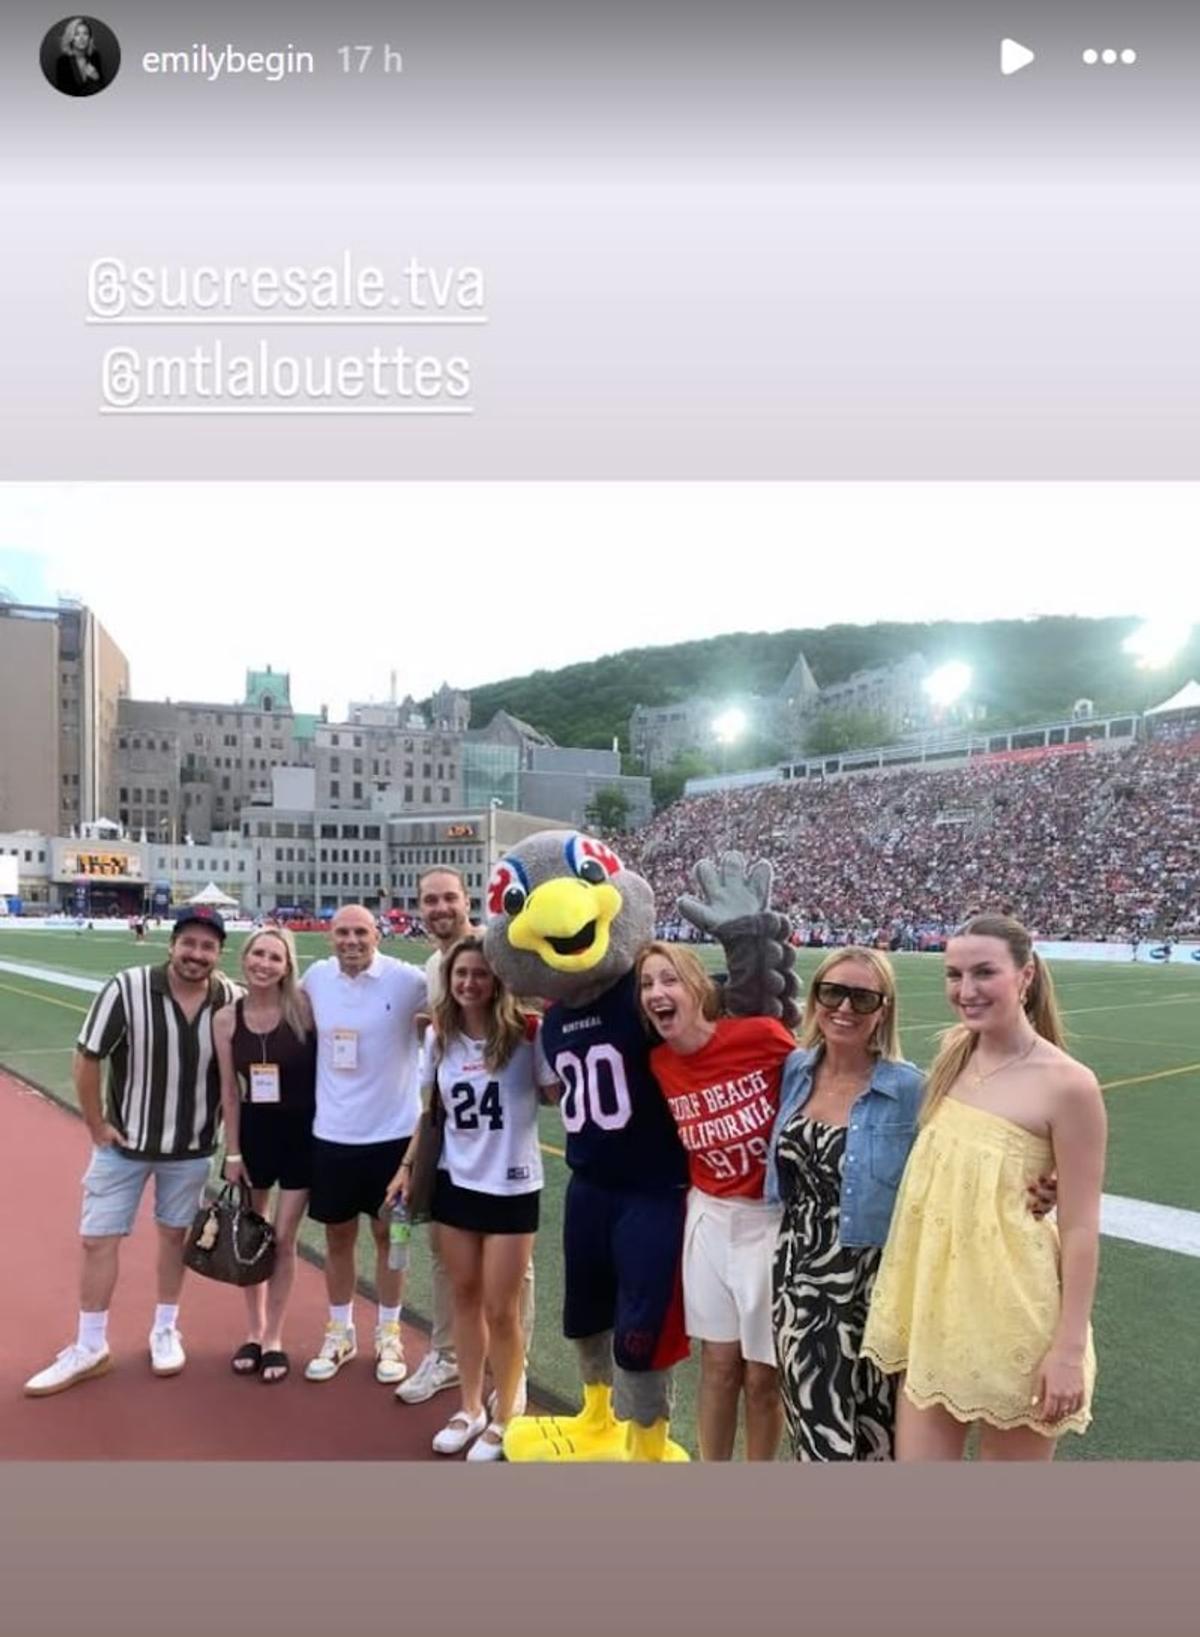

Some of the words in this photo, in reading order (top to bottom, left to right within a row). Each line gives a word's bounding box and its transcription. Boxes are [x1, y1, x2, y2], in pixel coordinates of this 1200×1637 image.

[451, 1081, 504, 1130] 24
[555, 1043, 632, 1133] 00
[701, 1070, 769, 1114] BEACH
[677, 1096, 775, 1151] ALIFORNIA
